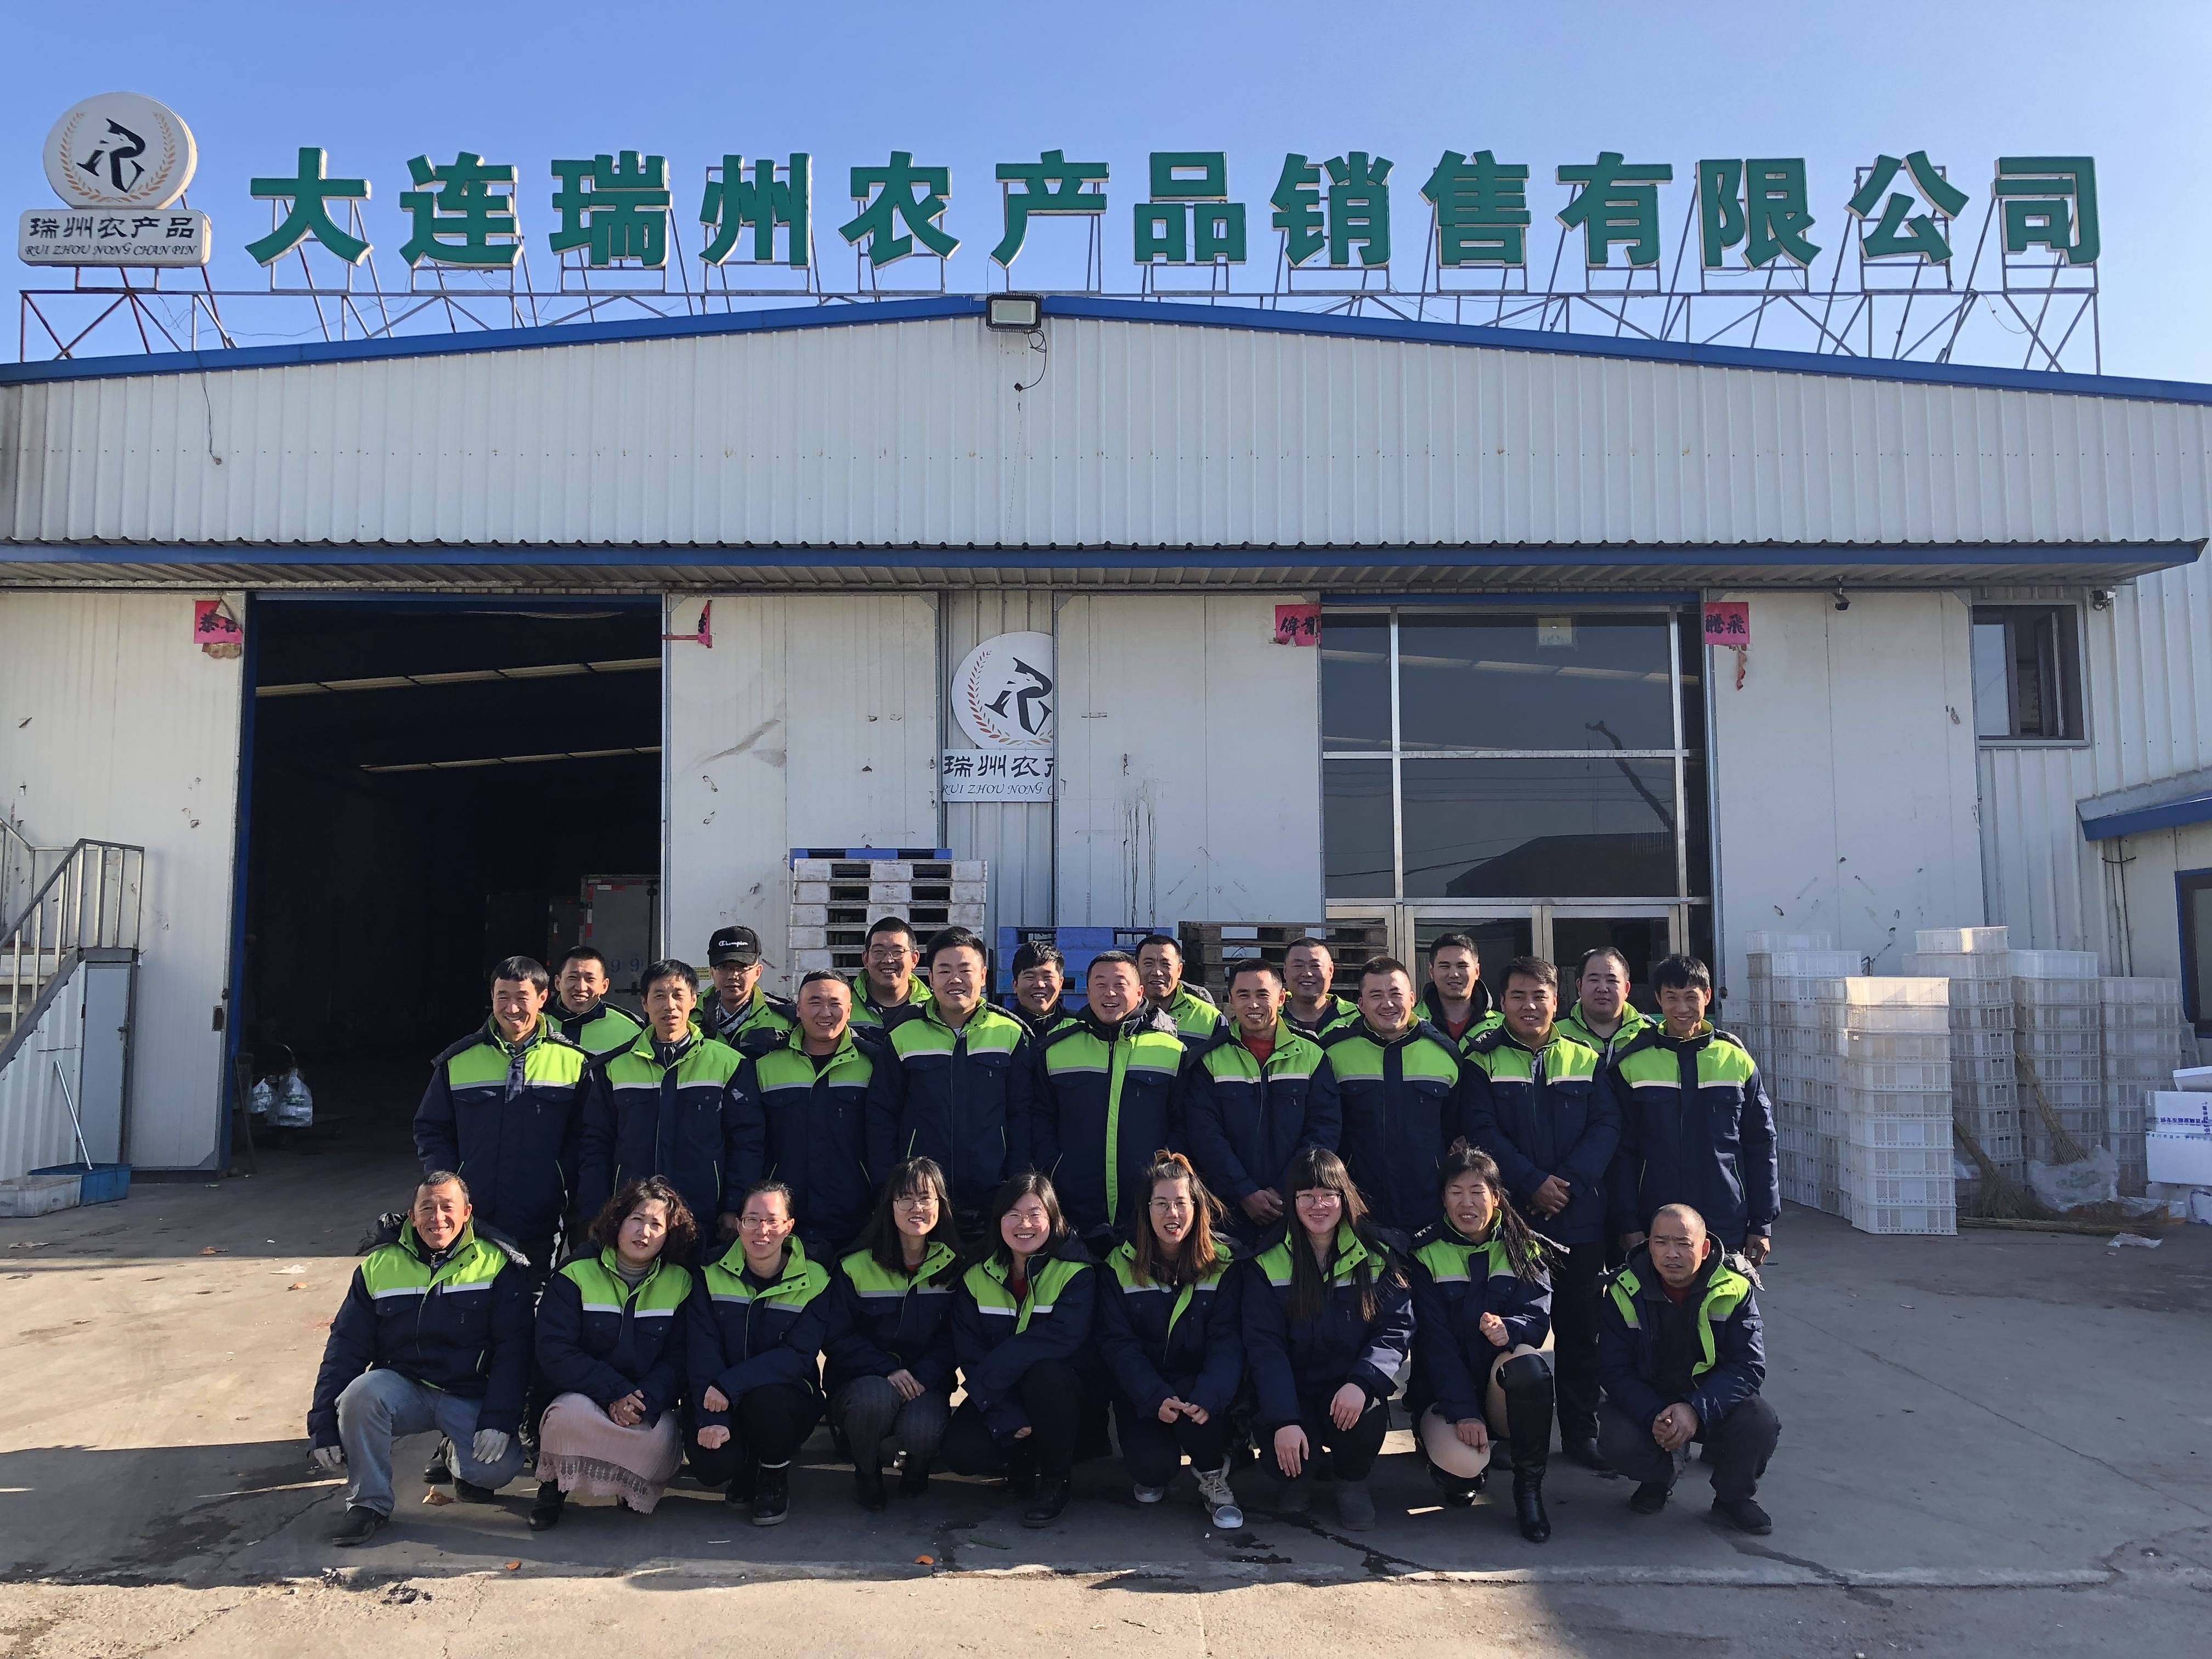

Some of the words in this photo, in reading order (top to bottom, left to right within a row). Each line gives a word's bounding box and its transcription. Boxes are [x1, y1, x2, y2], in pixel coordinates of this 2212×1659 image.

[245, 146, 2101, 272] 大连瑞州农产品销售有限公司
[29, 216, 195, 239] 瑞州农产品
[25, 245, 49, 256] RUI
[52, 244, 91, 256] ZHOU
[93, 242, 132, 256] NONG
[133, 245, 171, 256] CHAN
[171, 245, 198, 256] PIN
[942, 783, 963, 795] RUI
[967, 783, 1005, 794] ZHOU
[1007, 782, 1044, 795] NONG
